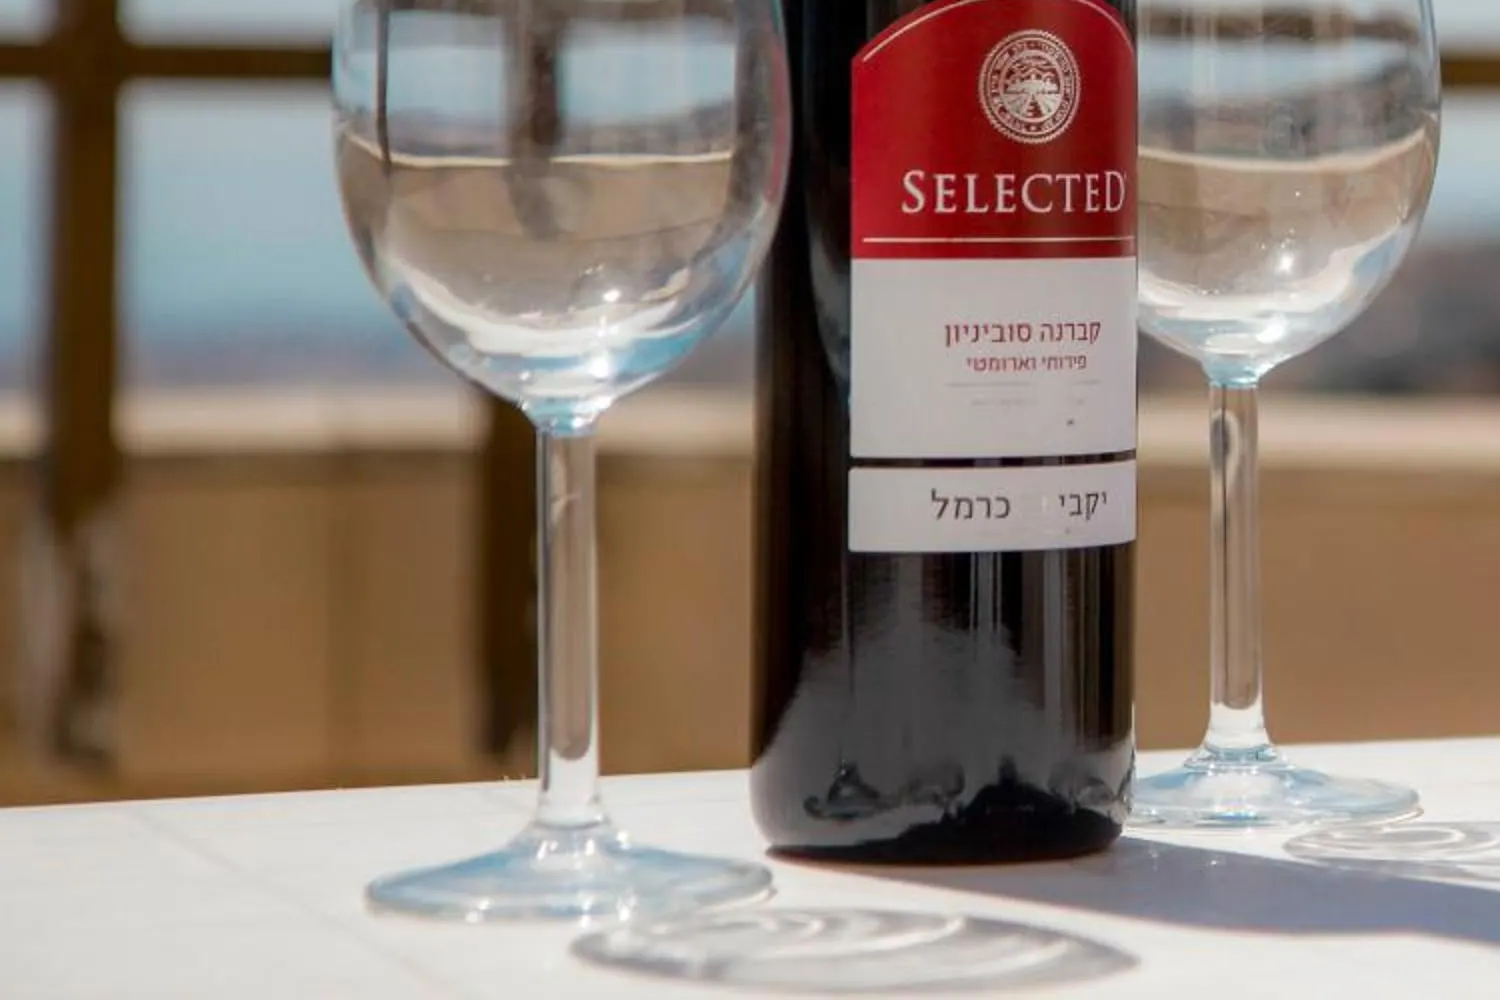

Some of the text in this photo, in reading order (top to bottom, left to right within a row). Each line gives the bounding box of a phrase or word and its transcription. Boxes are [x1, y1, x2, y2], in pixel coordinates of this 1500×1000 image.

[900, 169, 1126, 214] SELECTED
[944, 320, 1101, 348] קברנה סוביניון
[930, 488, 1107, 521] יקבי כרמל
